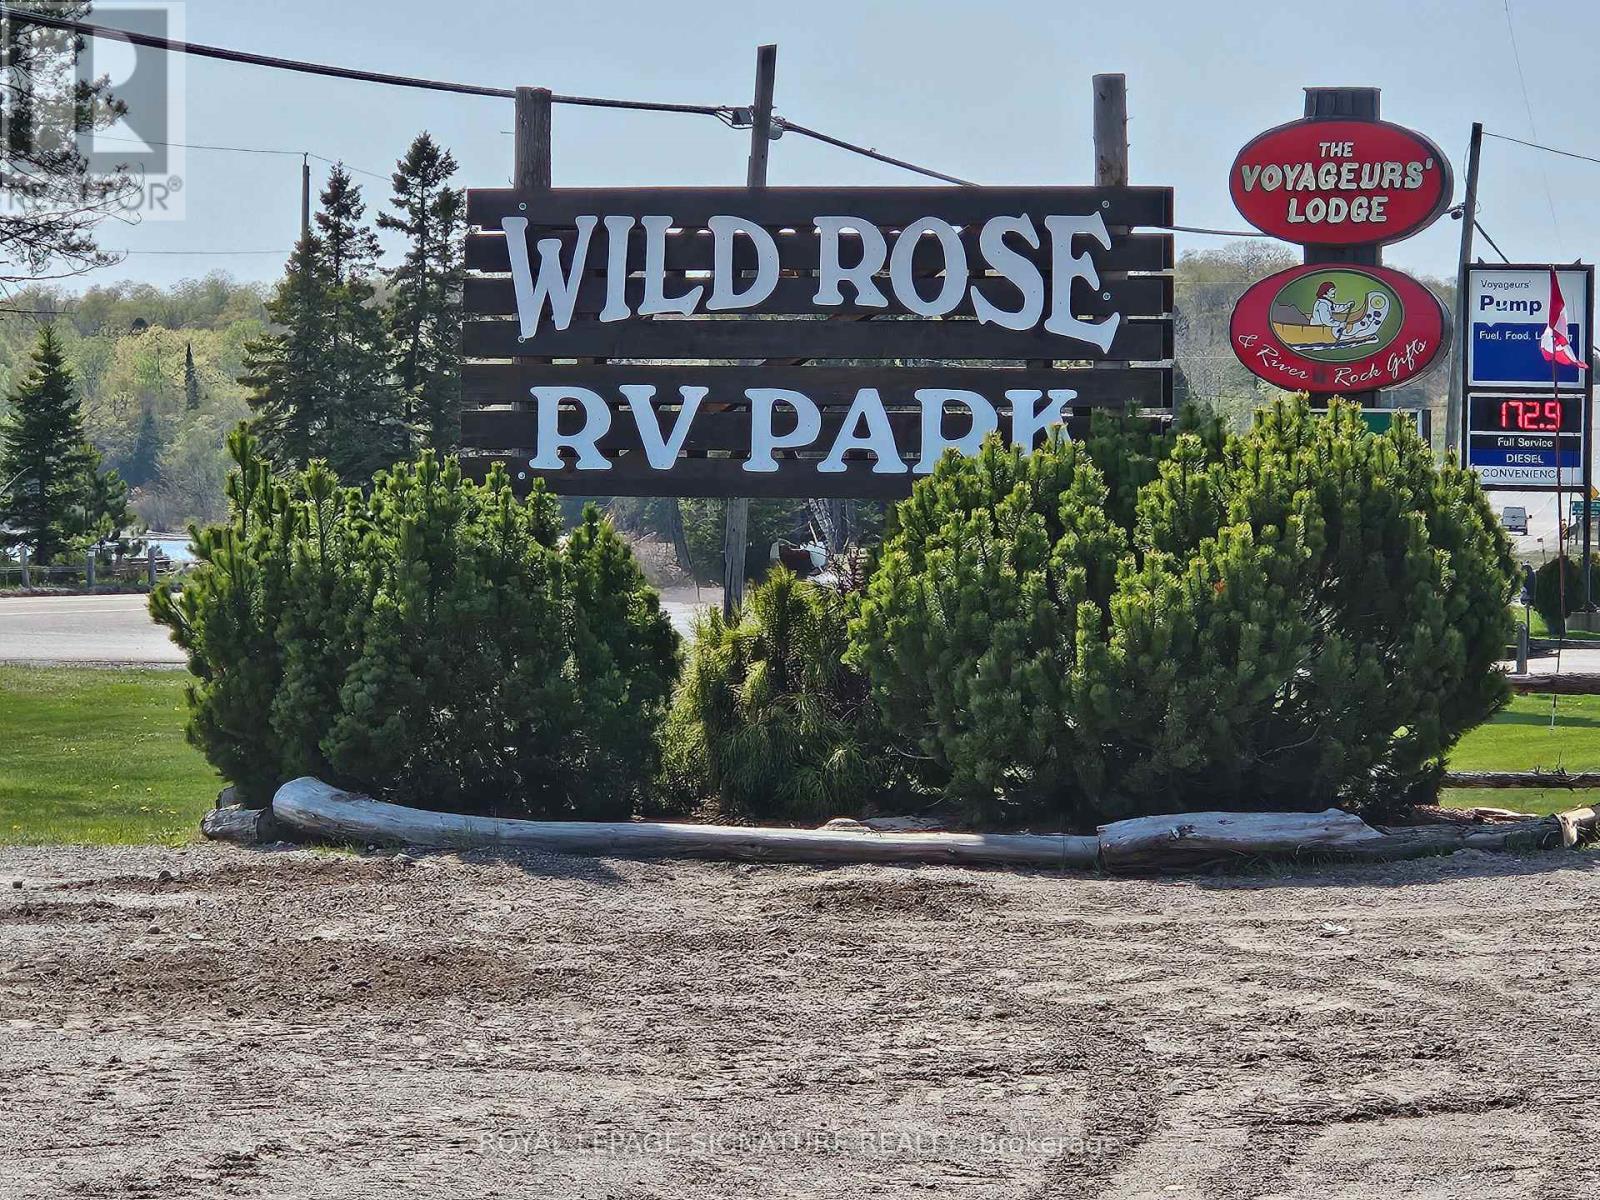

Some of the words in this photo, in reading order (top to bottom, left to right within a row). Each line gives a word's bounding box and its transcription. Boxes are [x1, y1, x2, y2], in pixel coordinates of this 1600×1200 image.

[1319, 142, 1354, 158] THE
[1241, 158, 1434, 192] VOYAGEURS'
[1287, 196, 1388, 224] LODGE
[501, 214, 781, 340] WILD
[812, 211, 1121, 354] ROSE
[1480, 280, 1532, 291] Voyageurs'
[1480, 295, 1543, 316] Pump
[1257, 344, 1309, 379] River
[1334, 363, 1383, 387] Rock
[1387, 338, 1427, 379] Gifts
[529, 384, 710, 471] RV
[742, 388, 1078, 474] PARK
[1501, 401, 1560, 429] 172.9
[1497, 437, 1515, 447] Full
[1518, 437, 1553, 448] Service
[1506, 454, 1544, 464] DIESEL
